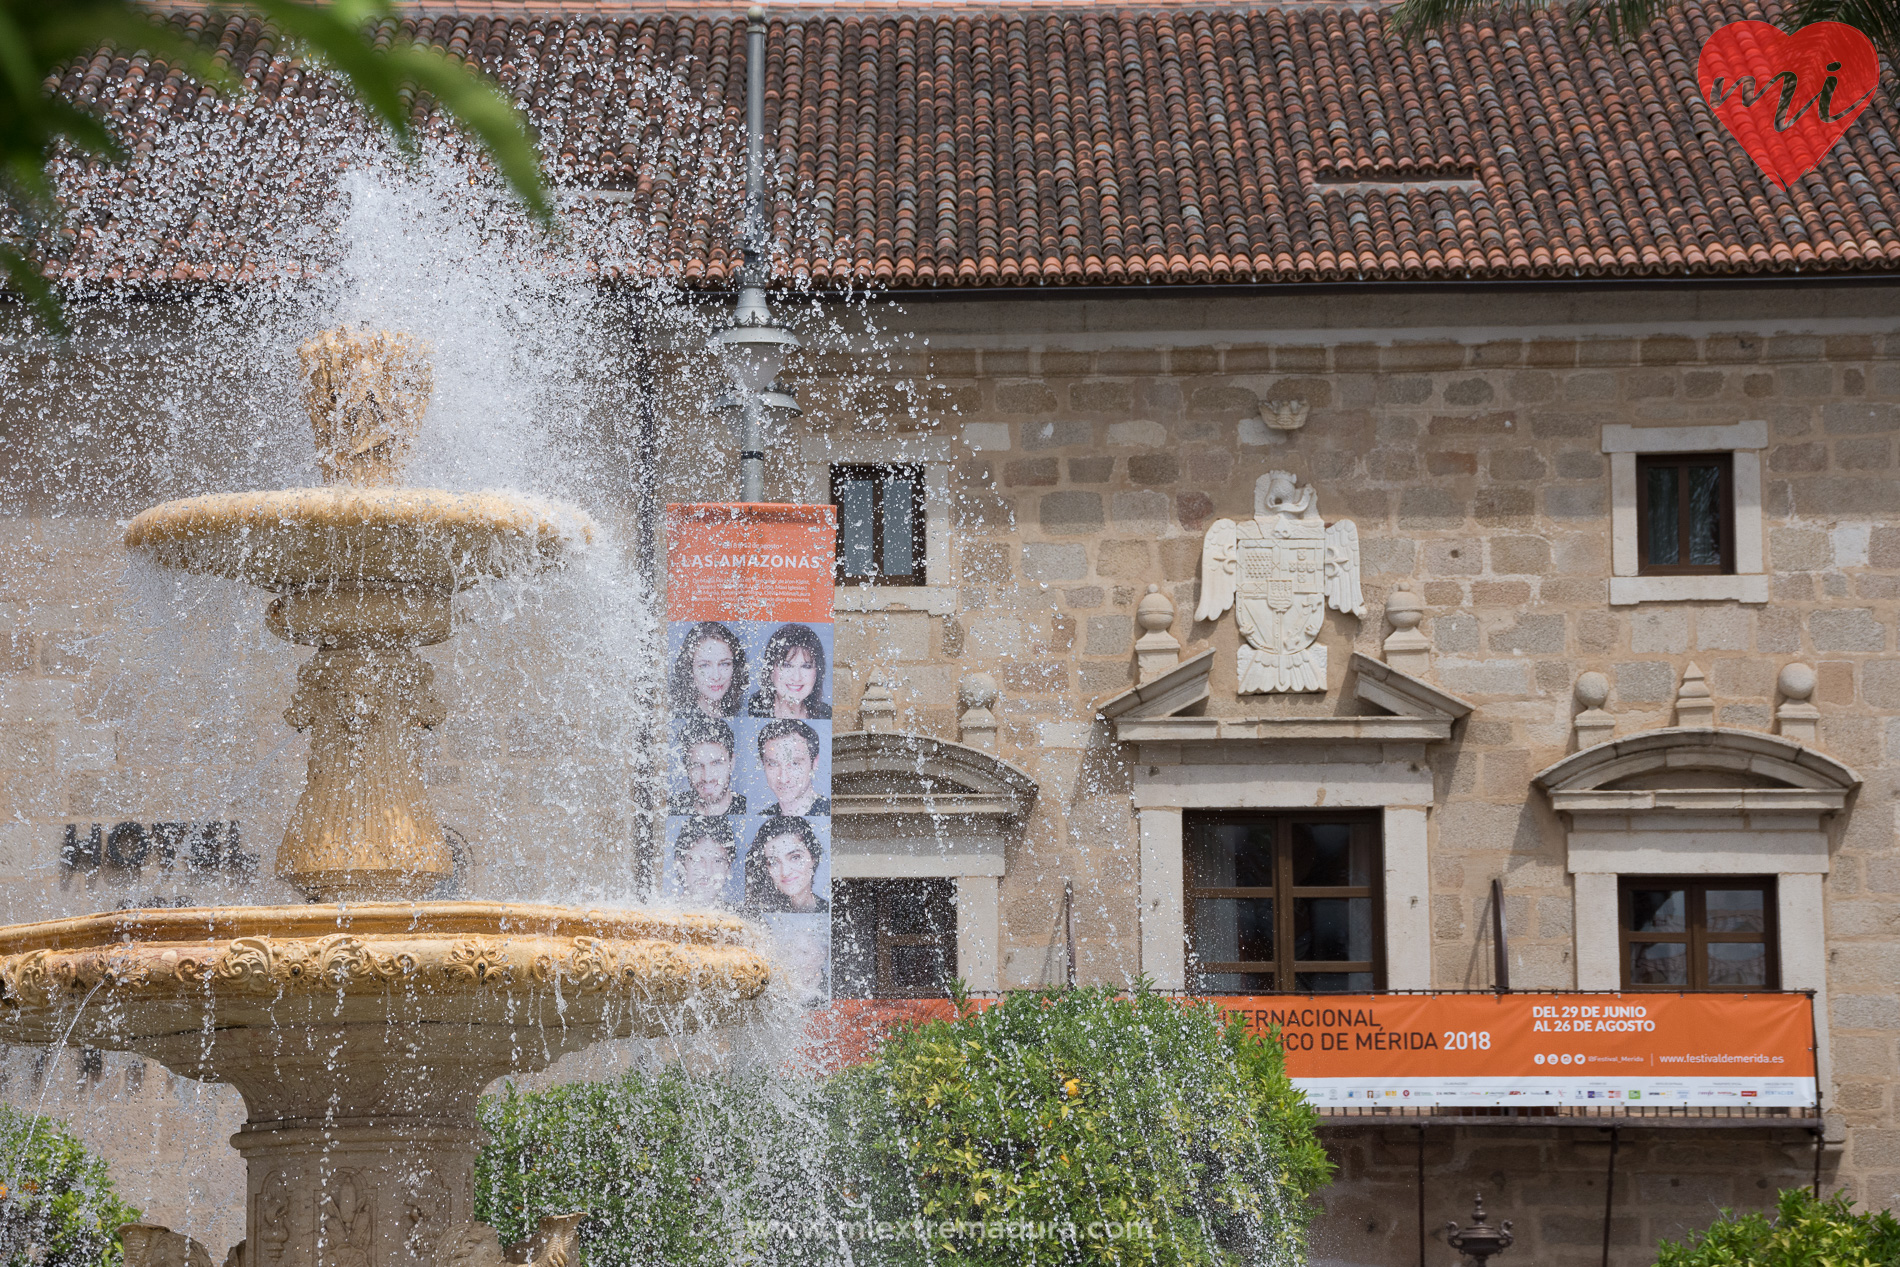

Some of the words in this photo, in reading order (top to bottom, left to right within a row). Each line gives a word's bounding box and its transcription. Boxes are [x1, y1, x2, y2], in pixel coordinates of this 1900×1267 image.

[681, 554, 713, 569] LAS
[719, 554, 820, 569] AMAZONAS
[60, 820, 261, 868] HOTEL
[1533, 1006, 1559, 1018] DEL
[1561, 1006, 1579, 1018] 29
[1581, 1006, 1600, 1018] DE
[1602, 1006, 1647, 1018] JUNIO
[1533, 1020, 1552, 1032] AL
[1554, 1020, 1571, 1032] 26
[1573, 1020, 1593, 1032] DE
[1595, 1020, 1656, 1032] AGOSTO
[1322, 1033, 1349, 1051] DE
[1356, 1027, 1438, 1051] MÉRIDA
[1443, 1031, 1491, 1051] 2018
[1588, 1055, 1644, 1064] @Festival_Merida
[1659, 1053, 1785, 1064] www.festivaldemerida.es
